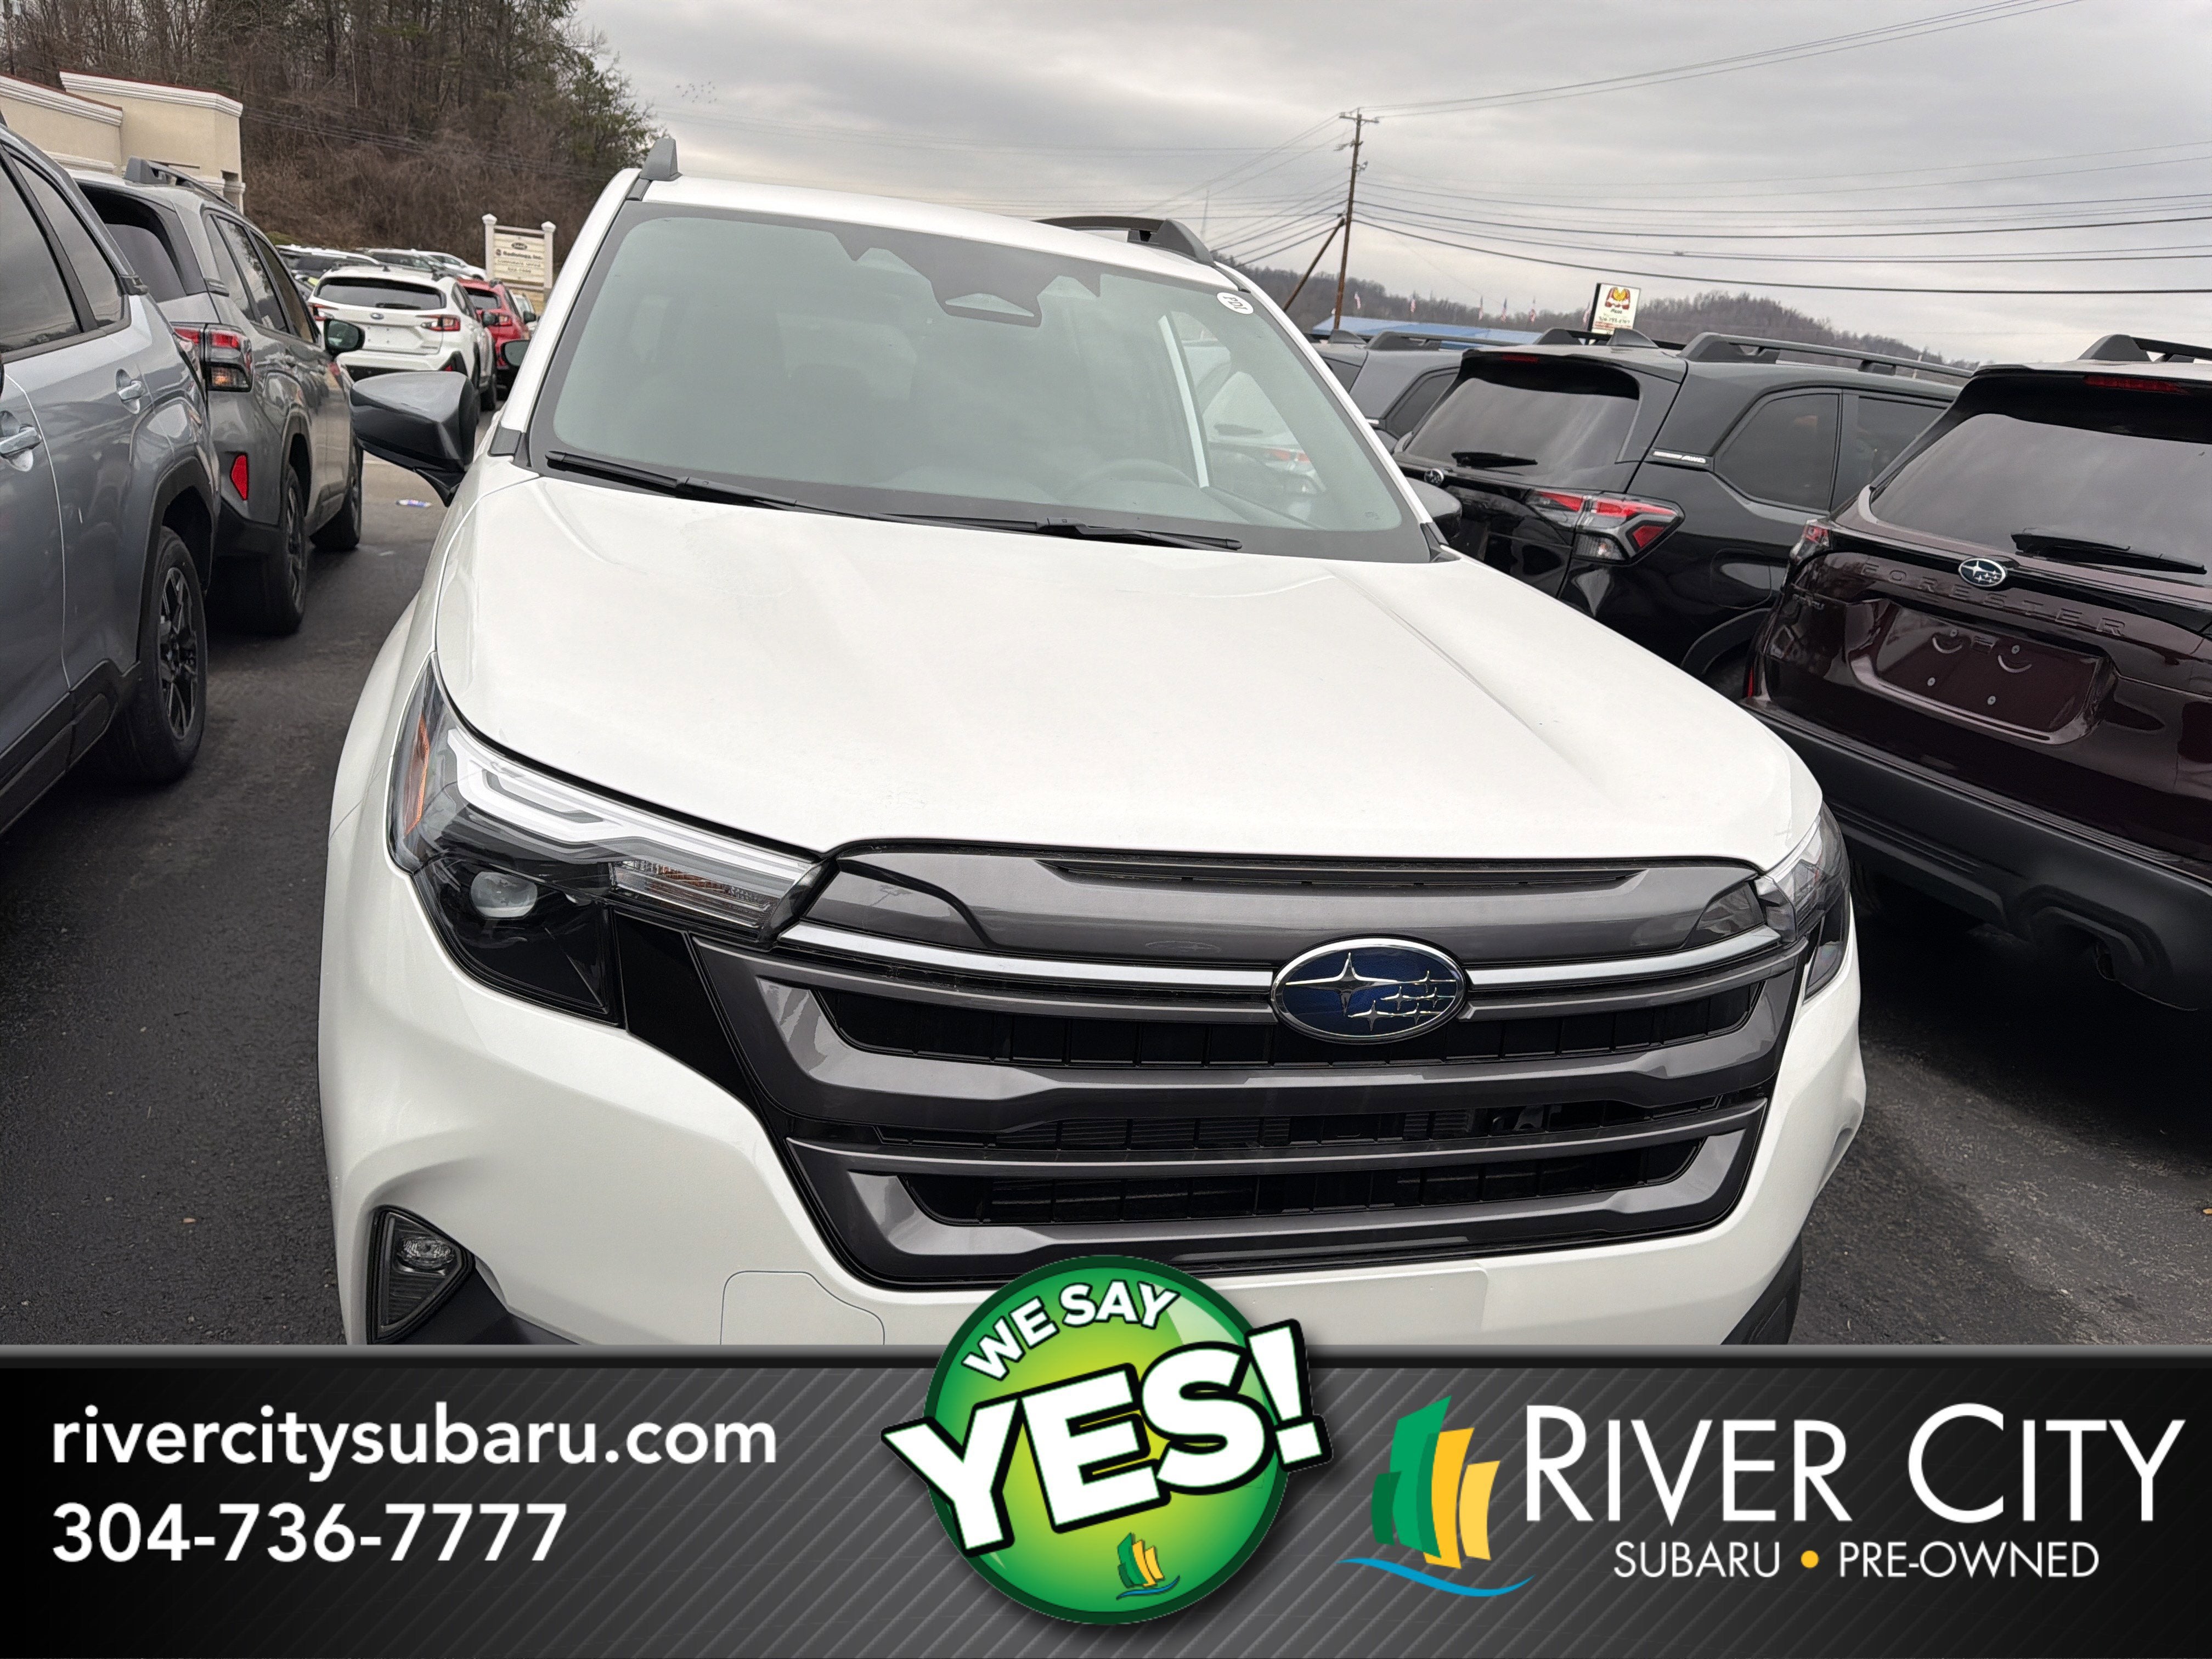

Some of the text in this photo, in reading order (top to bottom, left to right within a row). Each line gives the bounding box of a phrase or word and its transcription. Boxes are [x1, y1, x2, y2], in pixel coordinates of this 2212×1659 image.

[1222, 295, 1249, 311] PDI
[1681, 455, 1707, 464] AWD
[1861, 561, 2126, 637] FORESTER
